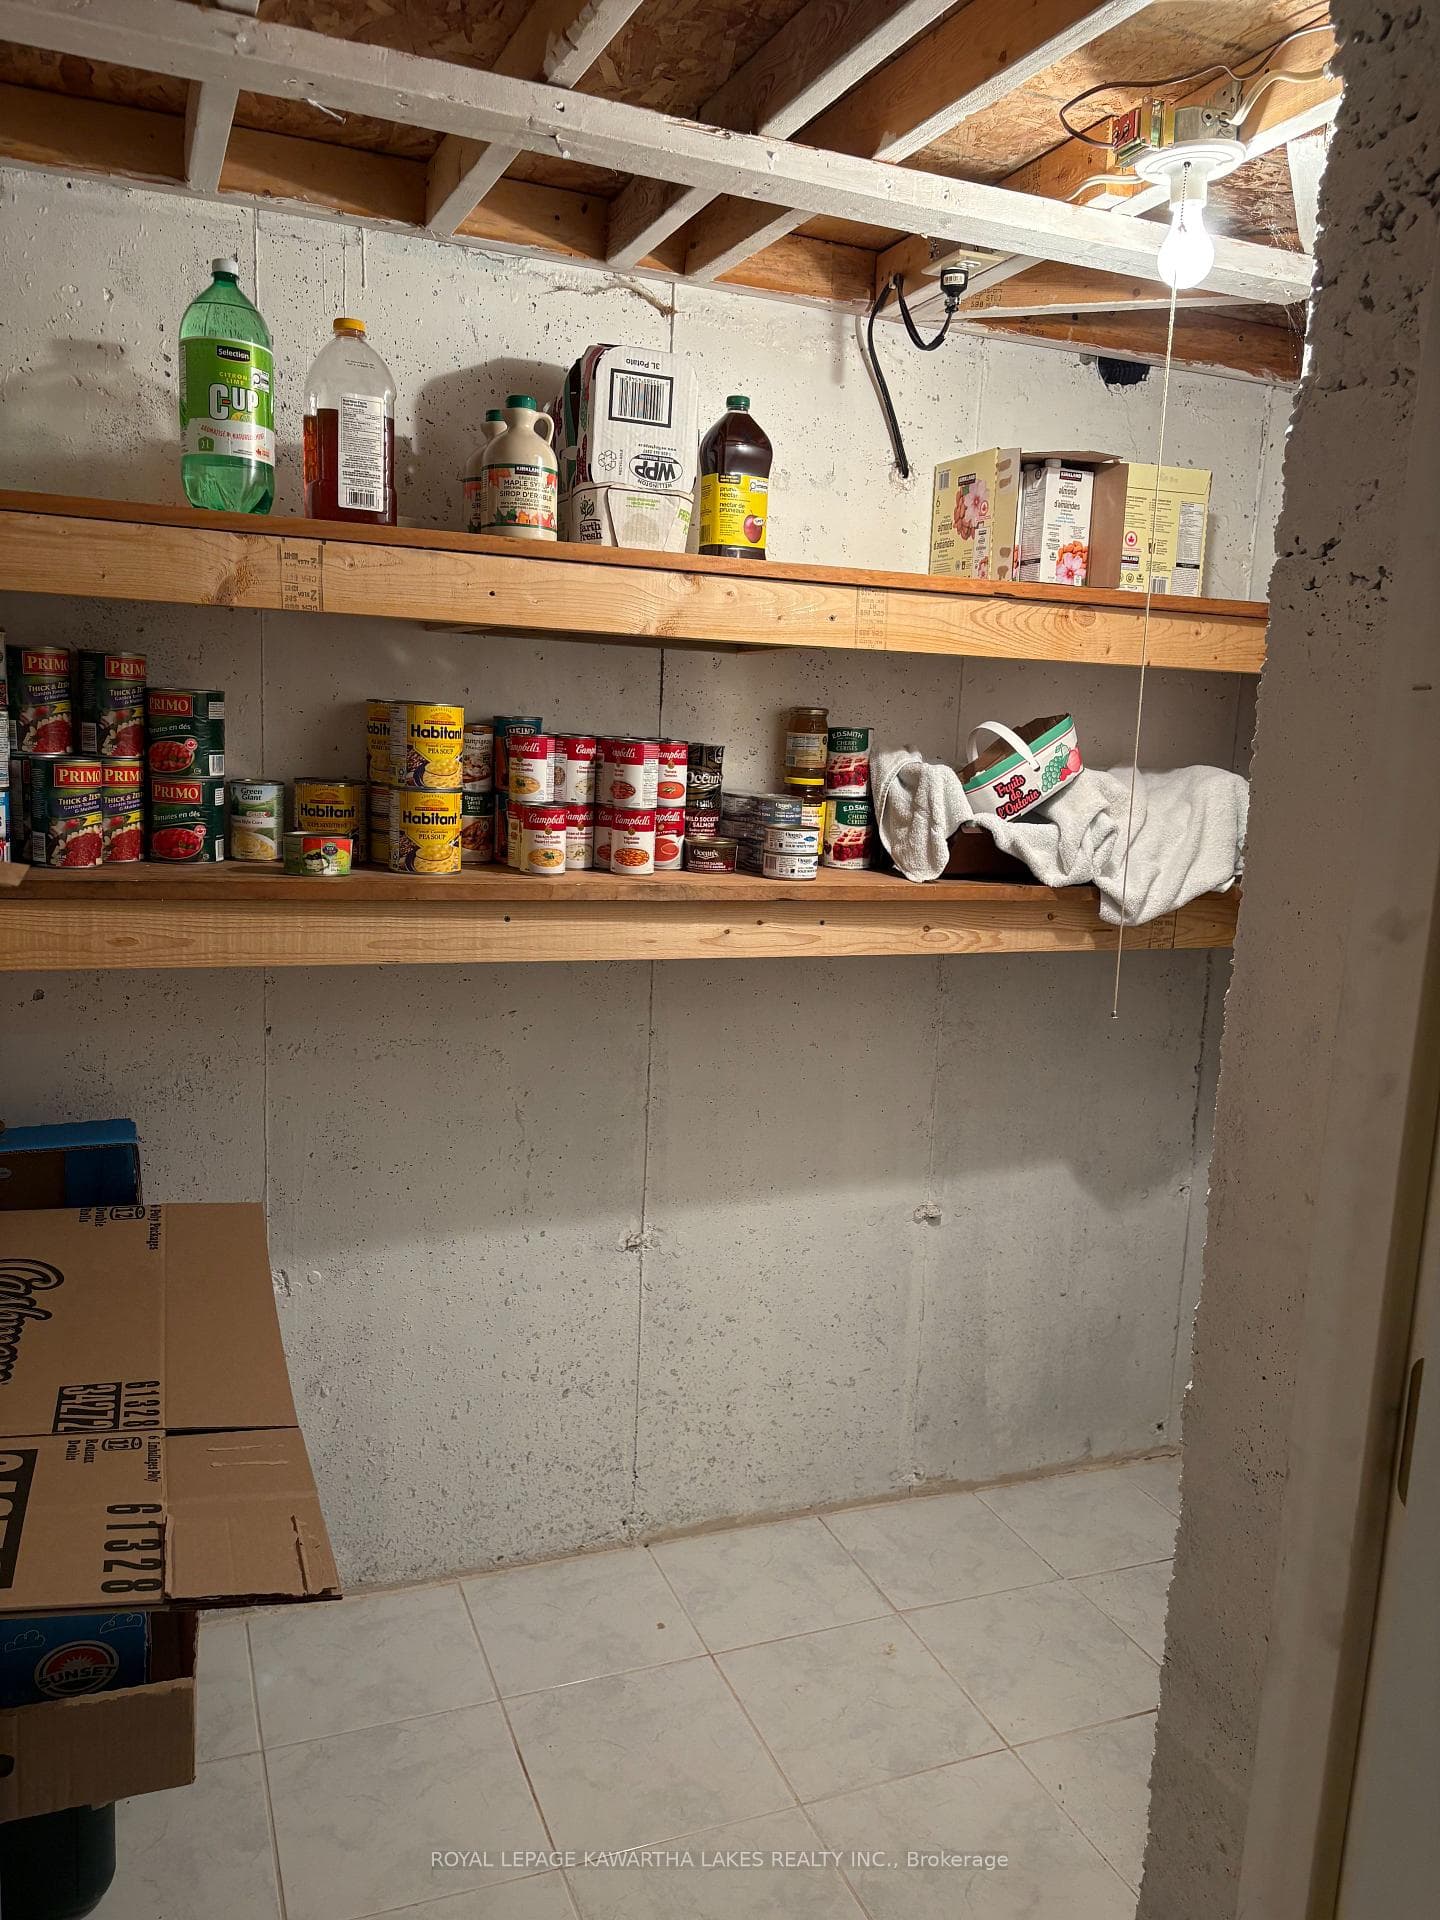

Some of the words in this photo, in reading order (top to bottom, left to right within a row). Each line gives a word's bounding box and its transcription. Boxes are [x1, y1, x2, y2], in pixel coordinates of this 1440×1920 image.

[218, 348, 250, 360] Selection
[626, 358, 650, 368] Potato
[219, 371, 248, 380] CITRON
[635, 460, 676, 481] WPP
[637, 479, 673, 489] WELLINGTON
[500, 490, 521, 498] SIROP
[1058, 487, 1078, 496] almond
[150, 697, 189, 711] PRIMO
[179, 722, 191, 730] dés
[367, 721, 391, 737] abit
[154, 784, 199, 800] PRIMO
[240, 787, 263, 795] Green
[994, 775, 1026, 798] Fruits
[58, 797, 81, 805] THICK
[104, 796, 125, 804] THICK
[241, 793, 262, 801] Giant
[1009, 788, 1023, 802] de
[300, 803, 356, 818] Habitant
[996, 789, 1042, 819] l'Ontario
[188, 810, 201, 818] dés
[402, 810, 457, 826] Habitant
[114, 1207, 134, 1219] 12
[147, 1208, 162, 1221] Poly
[146, 1223, 162, 1250] Packages
[57, 1384, 117, 1432] 34272
[123, 1380, 161, 1427] 61328
[107, 1439, 129, 1450] 12
[101, 1503, 163, 1594] 61328
[40, 1664, 116, 1689] SUNSET
